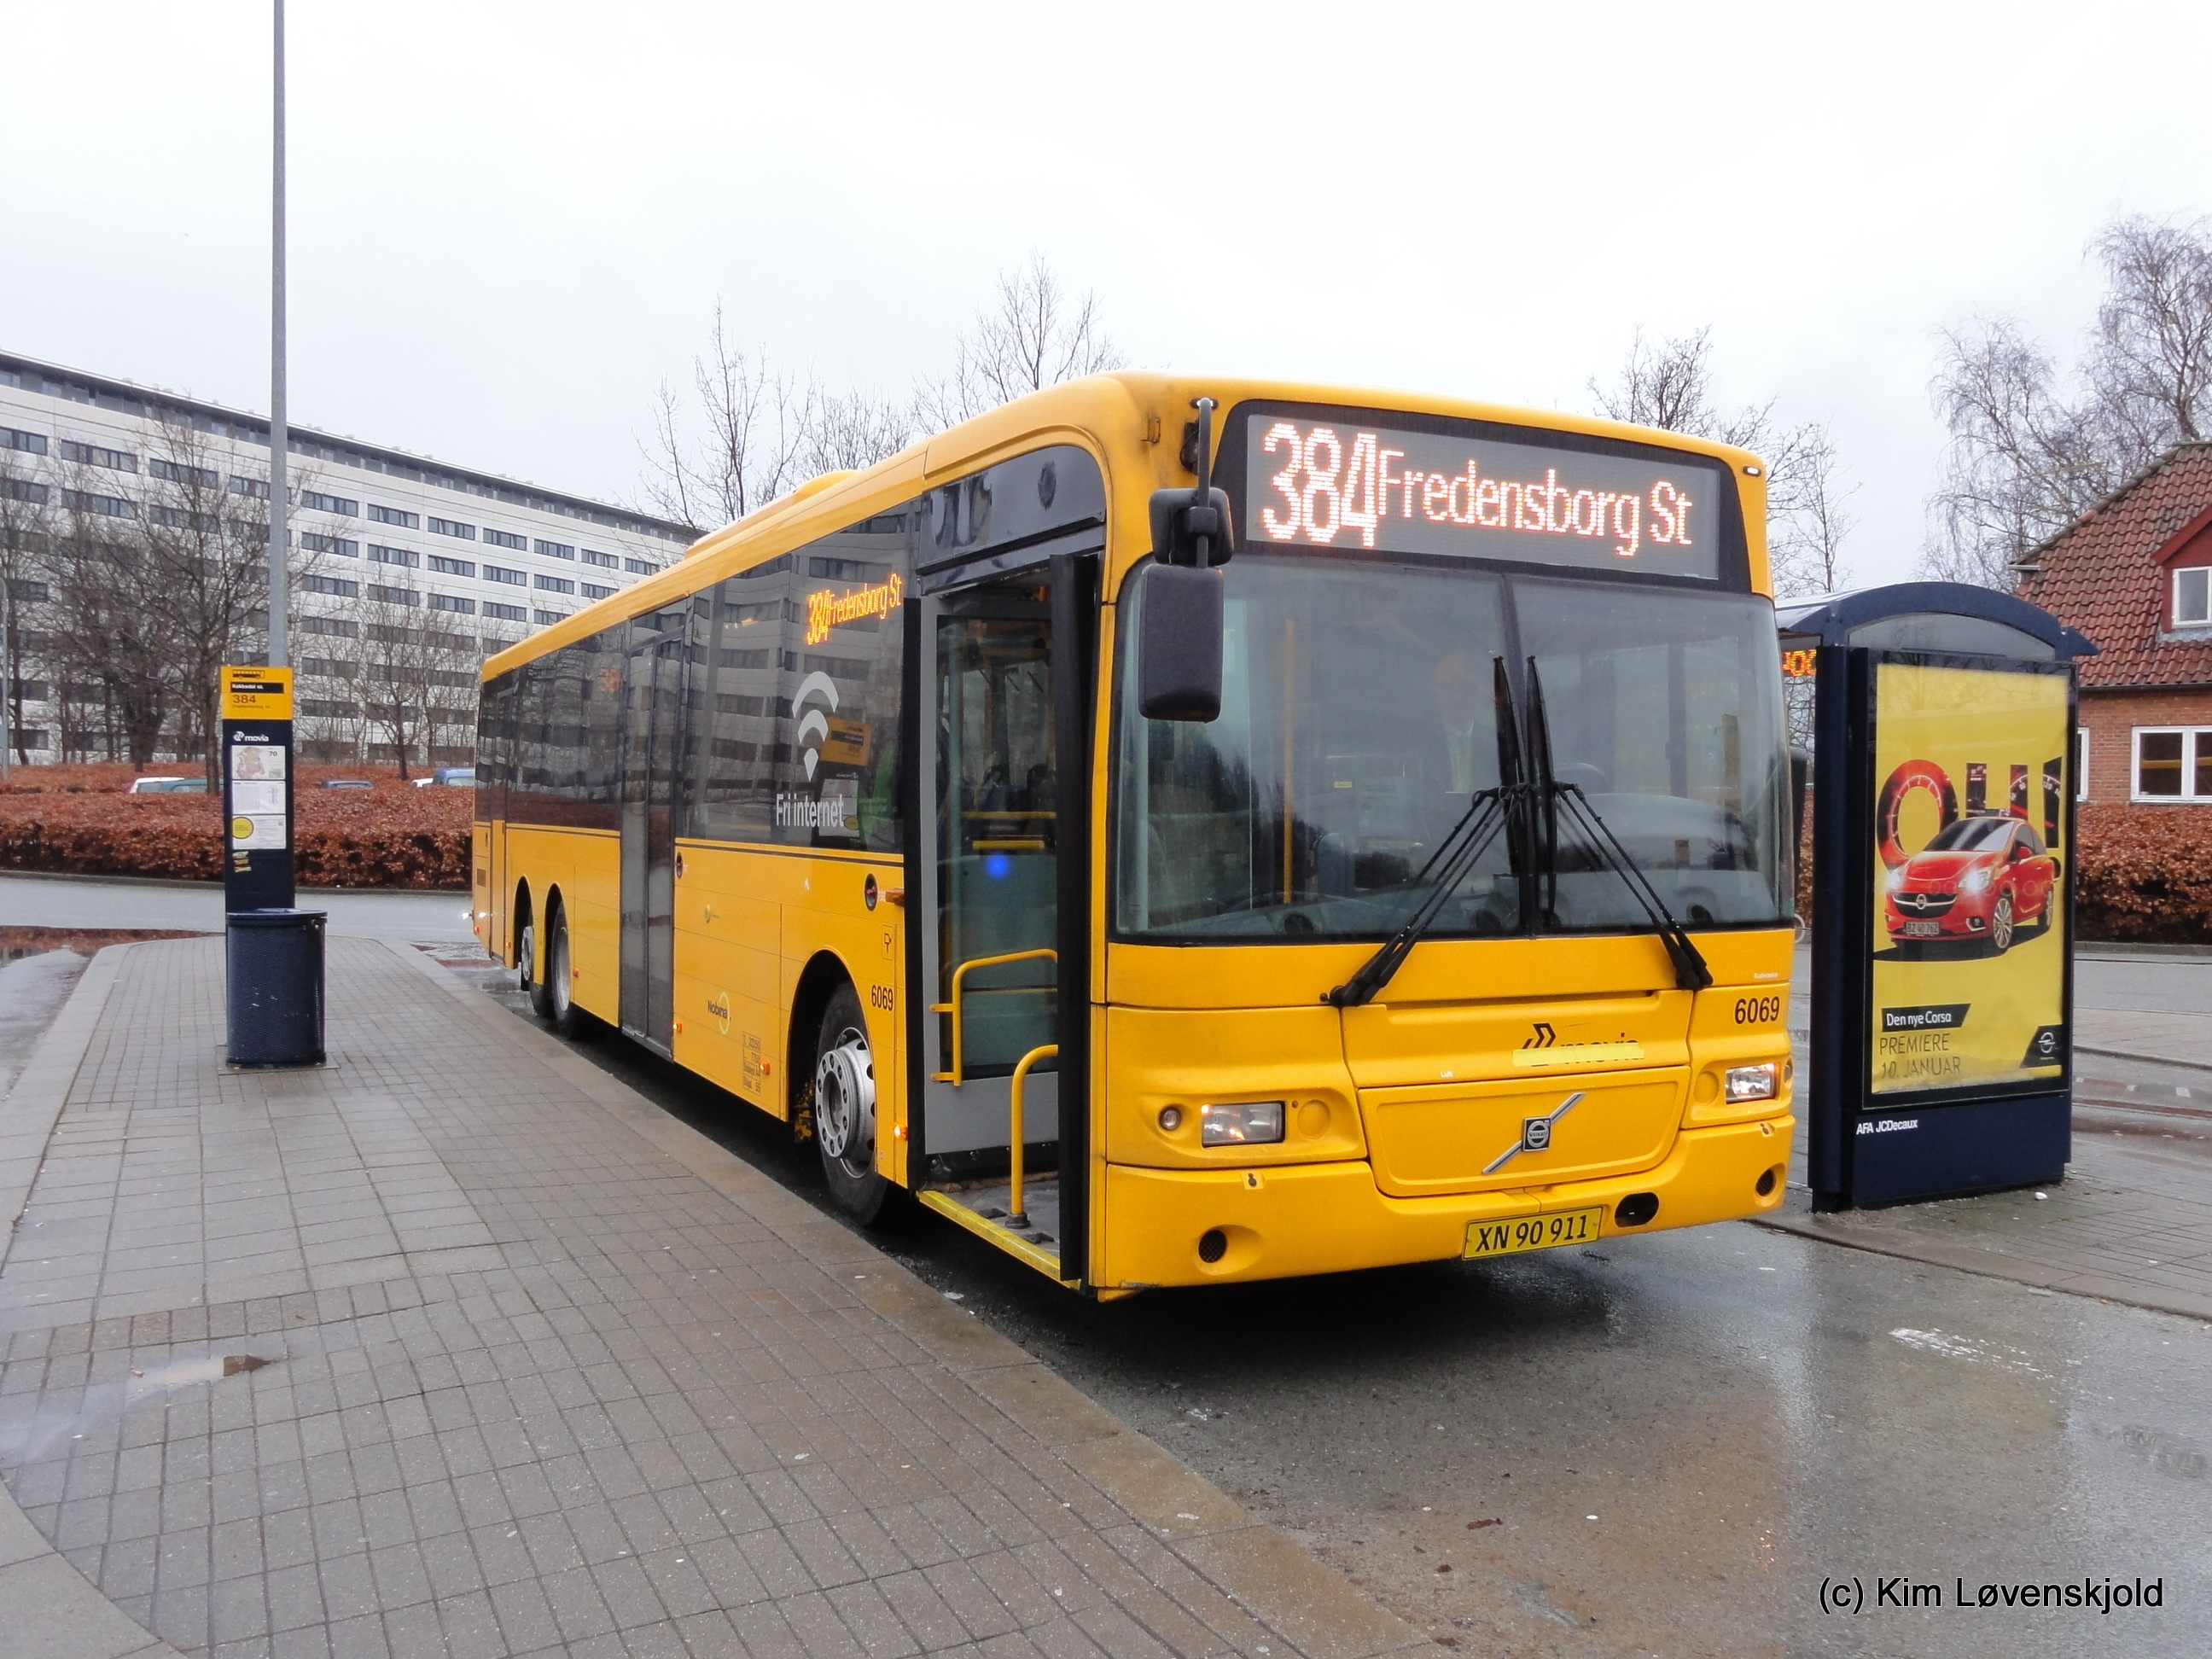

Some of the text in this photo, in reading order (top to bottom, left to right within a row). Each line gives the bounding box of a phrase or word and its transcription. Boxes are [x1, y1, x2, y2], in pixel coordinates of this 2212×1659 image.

[1263, 422, 1693, 557] 384 Fredensborg St
[806, 573, 903, 646] 384 Fredensborg St
[232, 695, 257, 704] 384
[777, 793, 845, 828] Fri internet
[707, 999, 729, 1020] Nobina
[871, 984, 894, 1011] 6069
[1734, 996, 1780, 1025] 6069
[1886, 1010, 1953, 1027] Den nye Corsa
[1879, 1033, 1950, 1056] PREMIERE
[1903, 1056, 1962, 1078] JANUAR
[1855, 1119, 1918, 1136] AFA JCDecaux
[1475, 1214, 1587, 1252] XN 90 911
